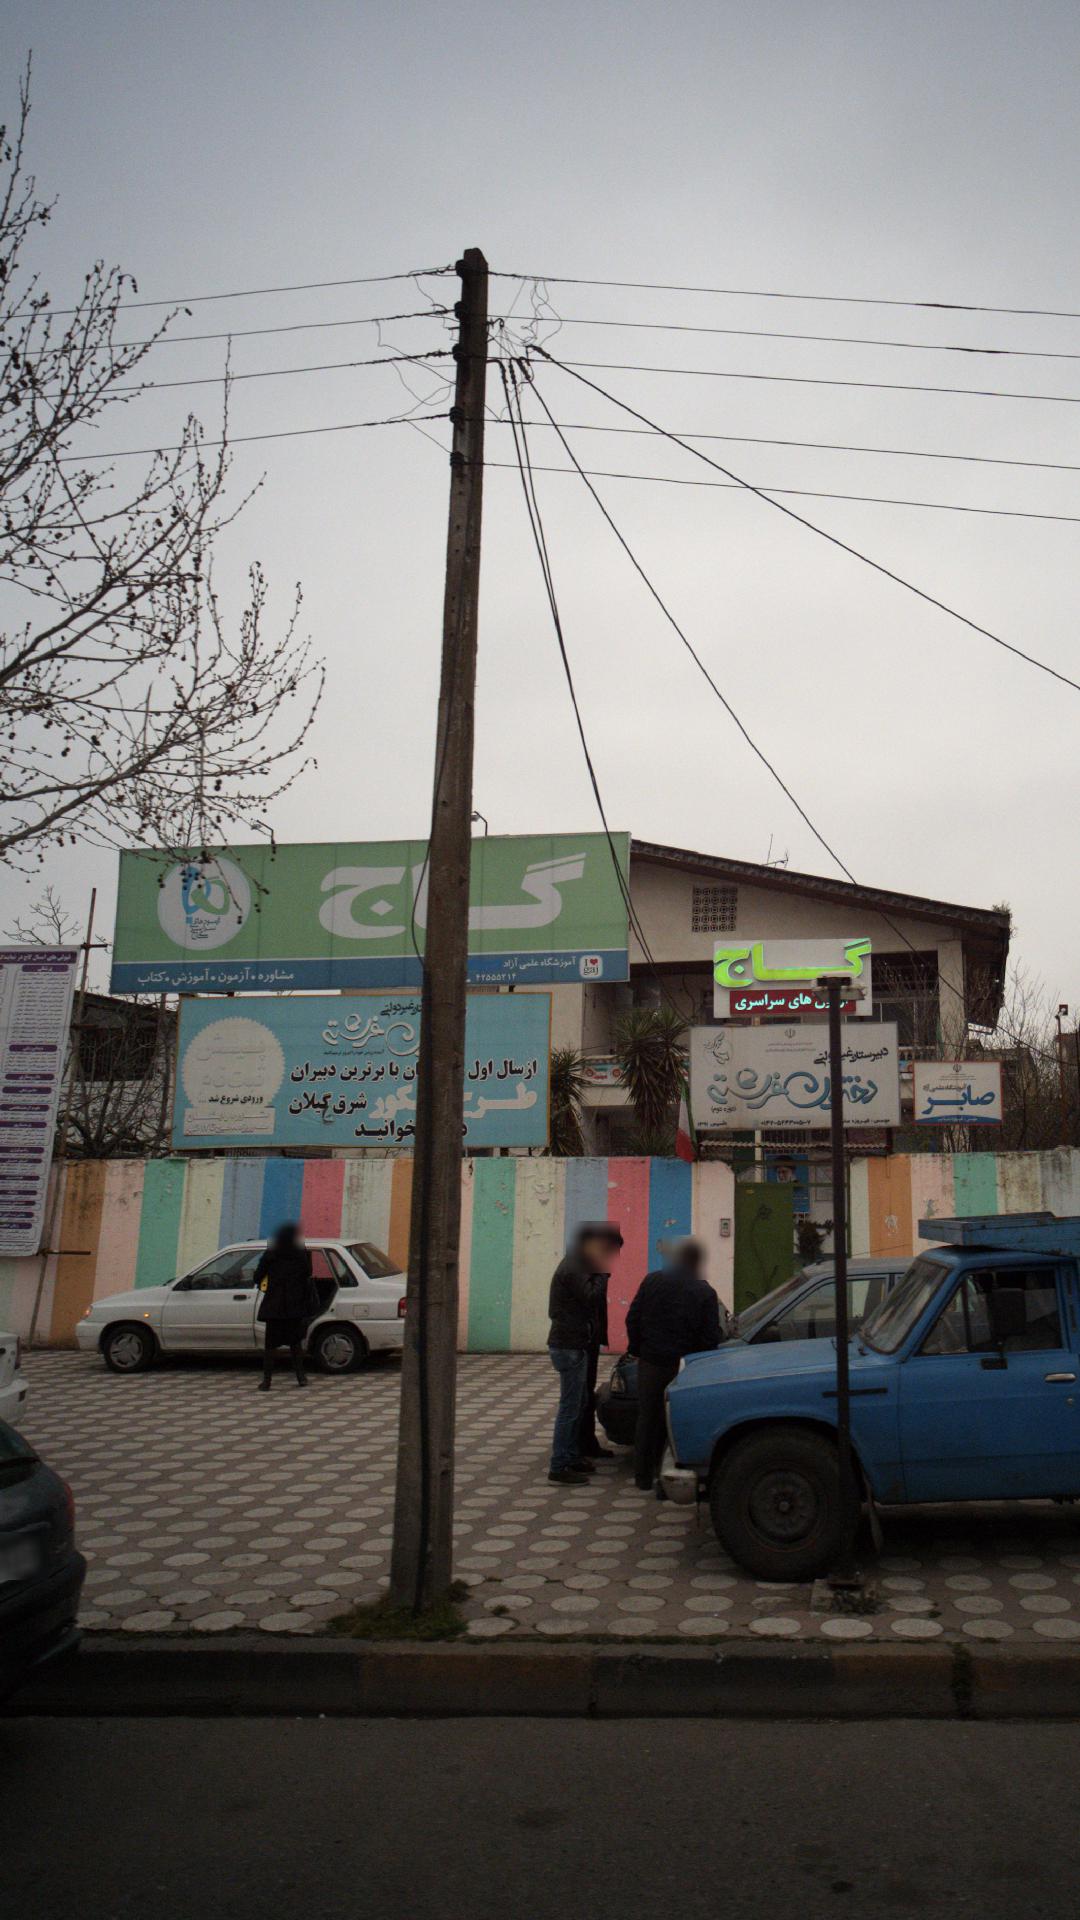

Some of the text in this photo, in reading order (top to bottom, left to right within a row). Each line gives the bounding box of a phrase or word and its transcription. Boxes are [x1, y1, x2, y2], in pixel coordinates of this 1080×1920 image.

[317, 853, 586, 940] گاج
[519, 958, 538, 970] علمی
[541, 956, 576, 969] آموزشگاه
[713, 937, 872, 989] گاج
[137, 967, 295, 987] مشاوره آزمون آموزش کتاب
[734, 994, 786, 1010] سراسری
[787, 993, 812, 1009] های
[290, 1061, 337, 1082] دبیران
[339, 1061, 386, 1082] برترین
[389, 1061, 400, 1081] با
[468, 1060, 493, 1081] اول
[497, 1059, 525, 1080] سال
[219, 1094, 240, 1105] شروع
[239, 1095, 264, 1104] ورودی
[288, 1092, 332, 1115] گیلان
[332, 1092, 368, 1115] شرق
[921, 1084, 996, 1115] صابر
[355, 1119, 416, 1142] خوانید
